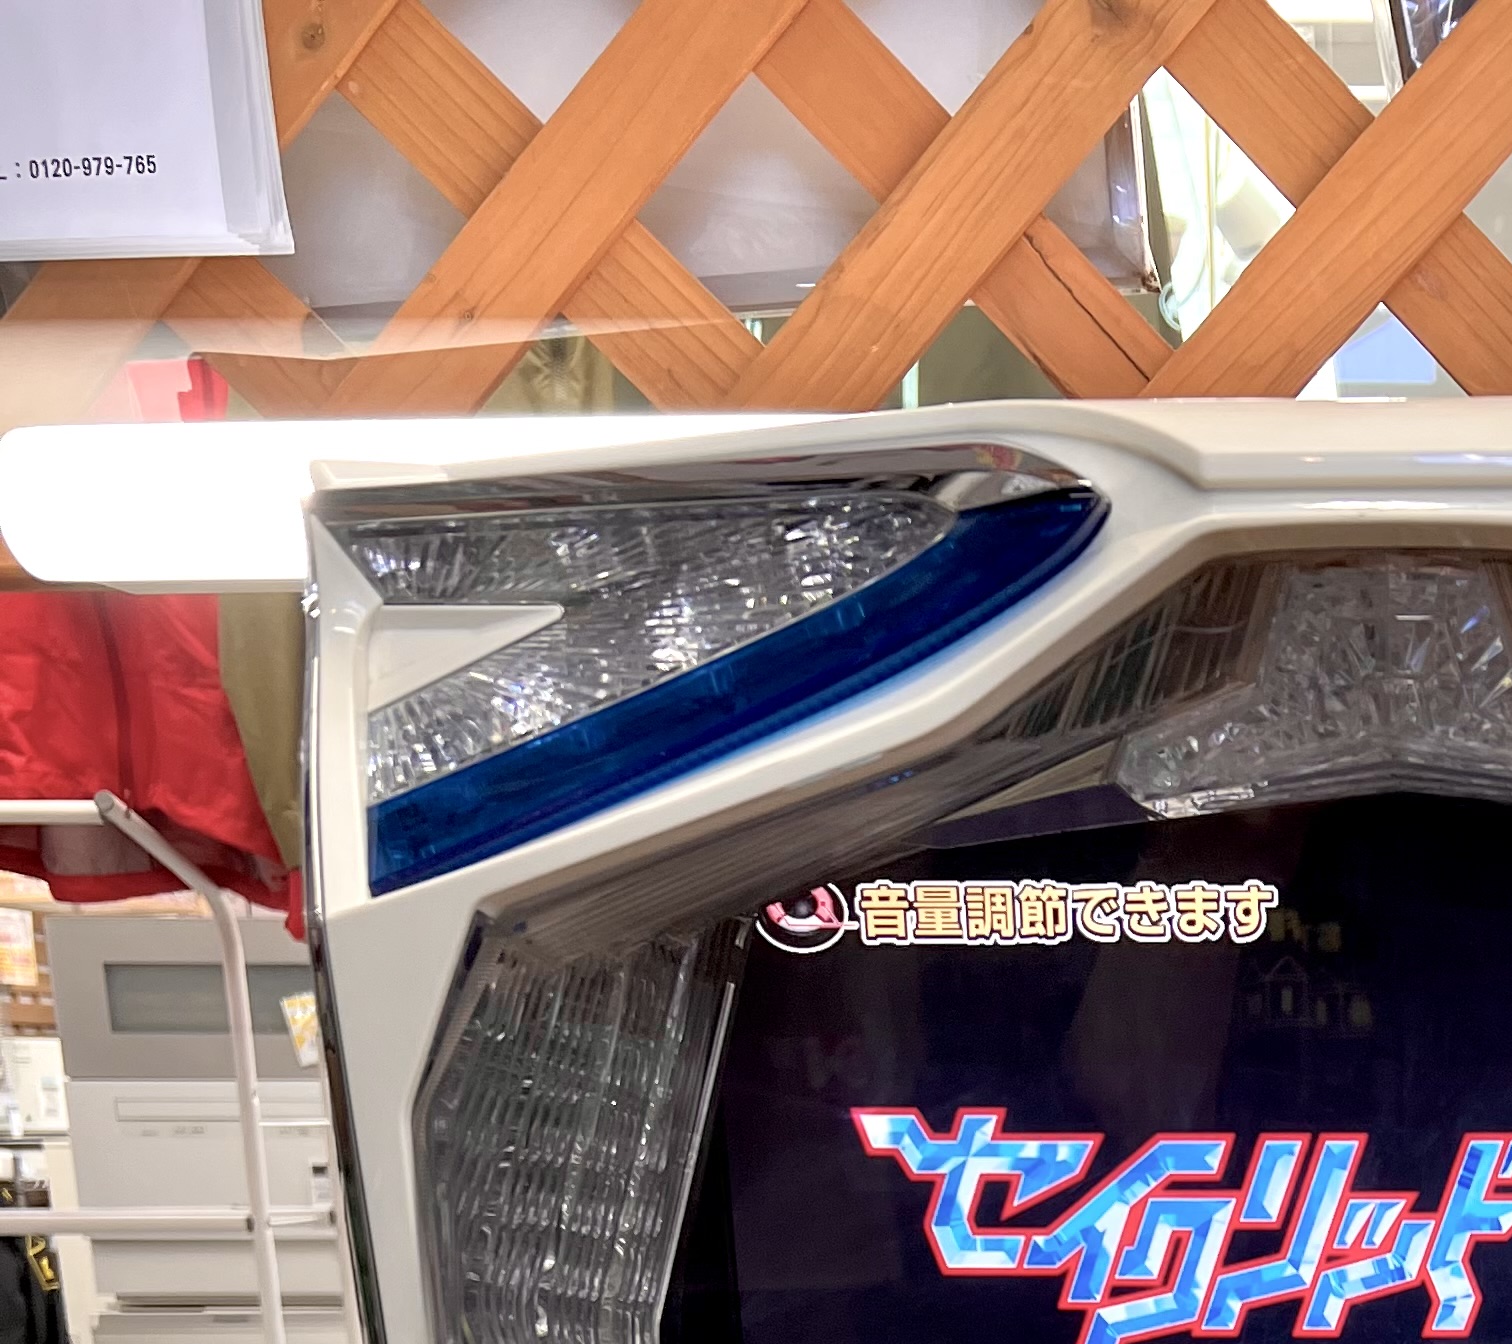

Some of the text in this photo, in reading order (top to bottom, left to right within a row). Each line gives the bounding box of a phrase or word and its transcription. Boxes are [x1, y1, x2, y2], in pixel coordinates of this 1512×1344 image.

[857, 880, 1279, 944] 音量調節できます
